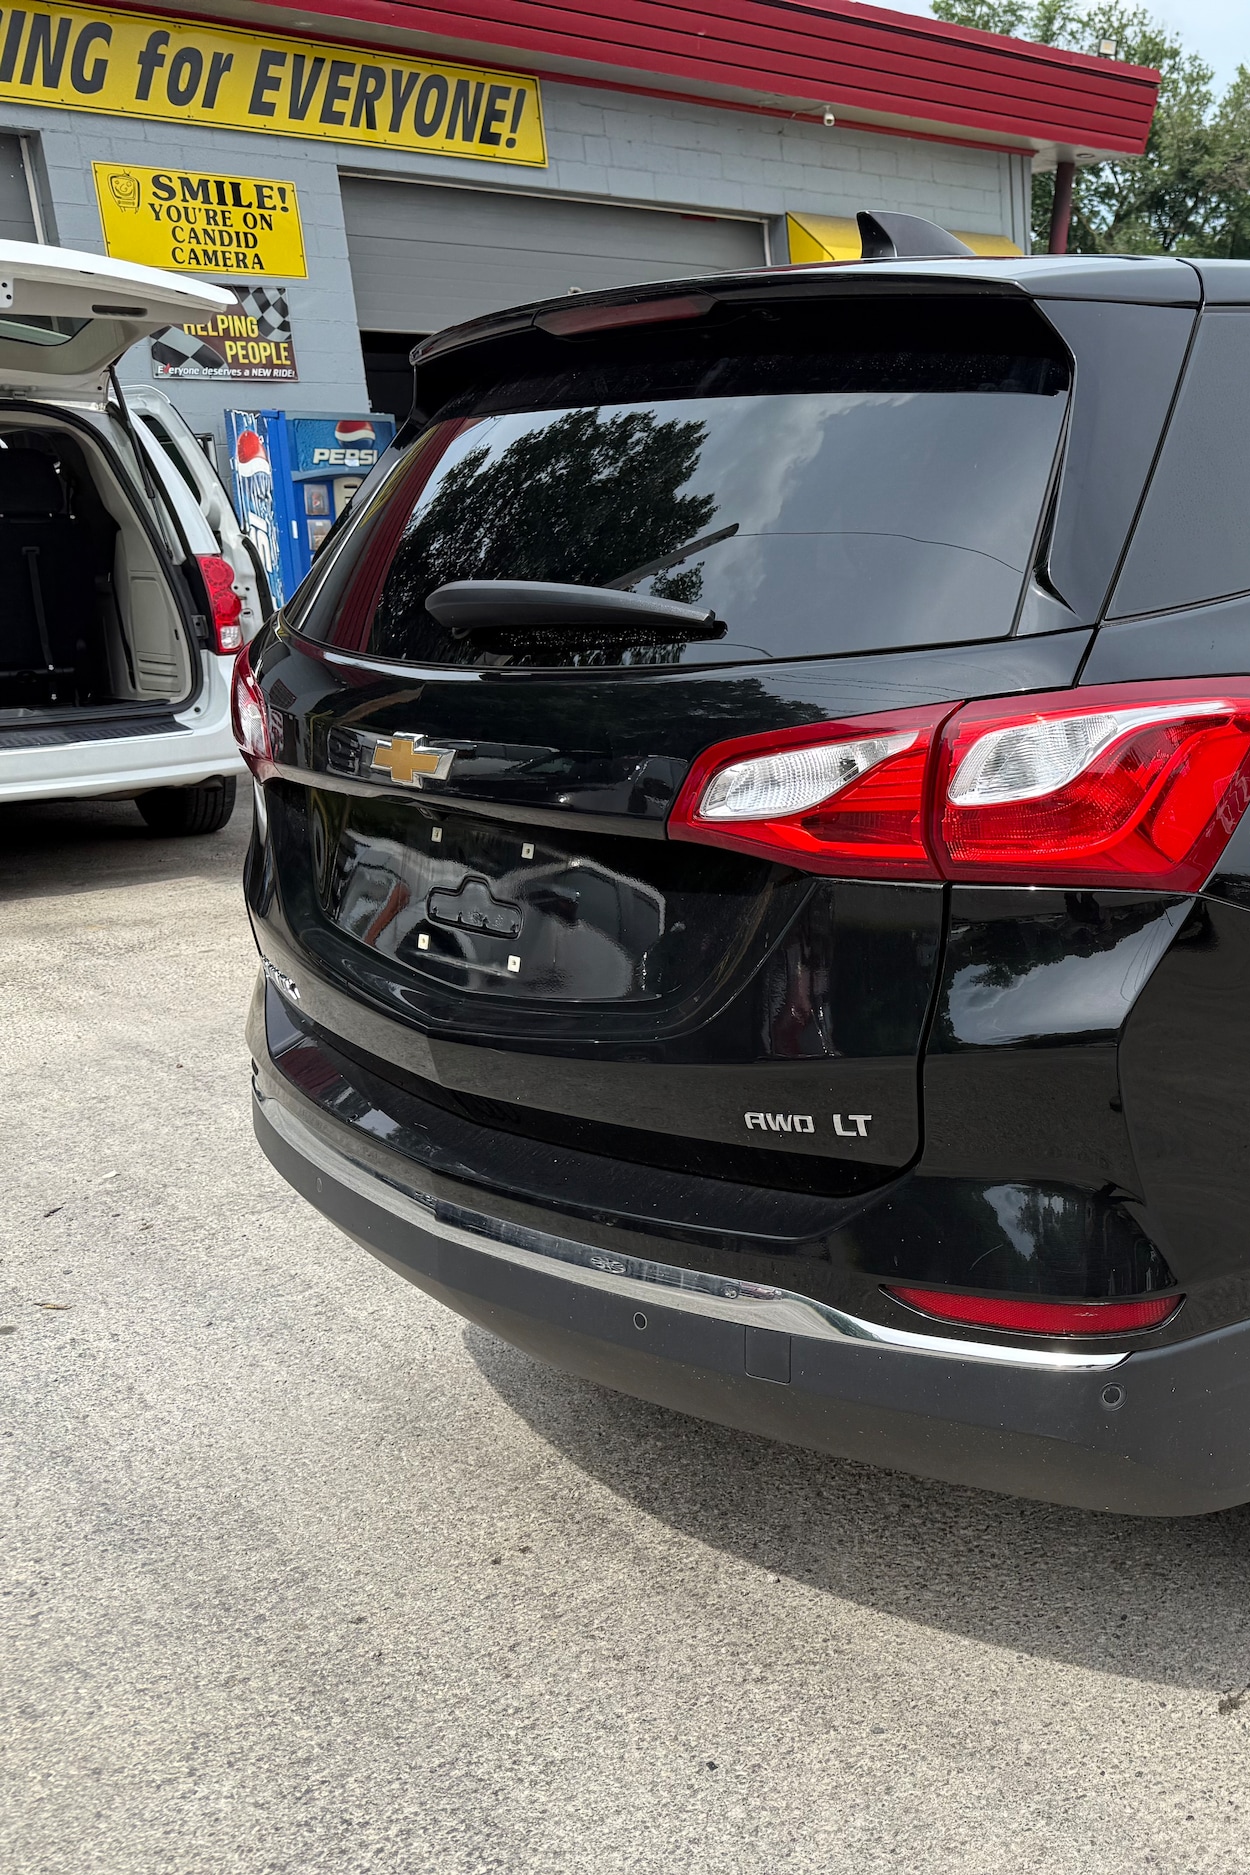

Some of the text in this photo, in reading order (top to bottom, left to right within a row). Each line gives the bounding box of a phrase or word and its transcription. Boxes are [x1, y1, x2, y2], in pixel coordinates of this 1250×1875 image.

[0, 8, 527, 149] ING for EVERYONE!
[151, 174, 289, 213] SMILE!
[148, 202, 273, 231] YOU'RE ON
[171, 225, 258, 249] CANDID
[171, 246, 265, 270] CAMERA
[224, 341, 291, 365] PEOPLE
[202, 366, 242, 377] deserves
[252, 368, 272, 377] NEW
[273, 368, 295, 378] RIDE!
[312, 448, 378, 465] PEPSI
[744, 1111, 872, 1137] AWD LT
